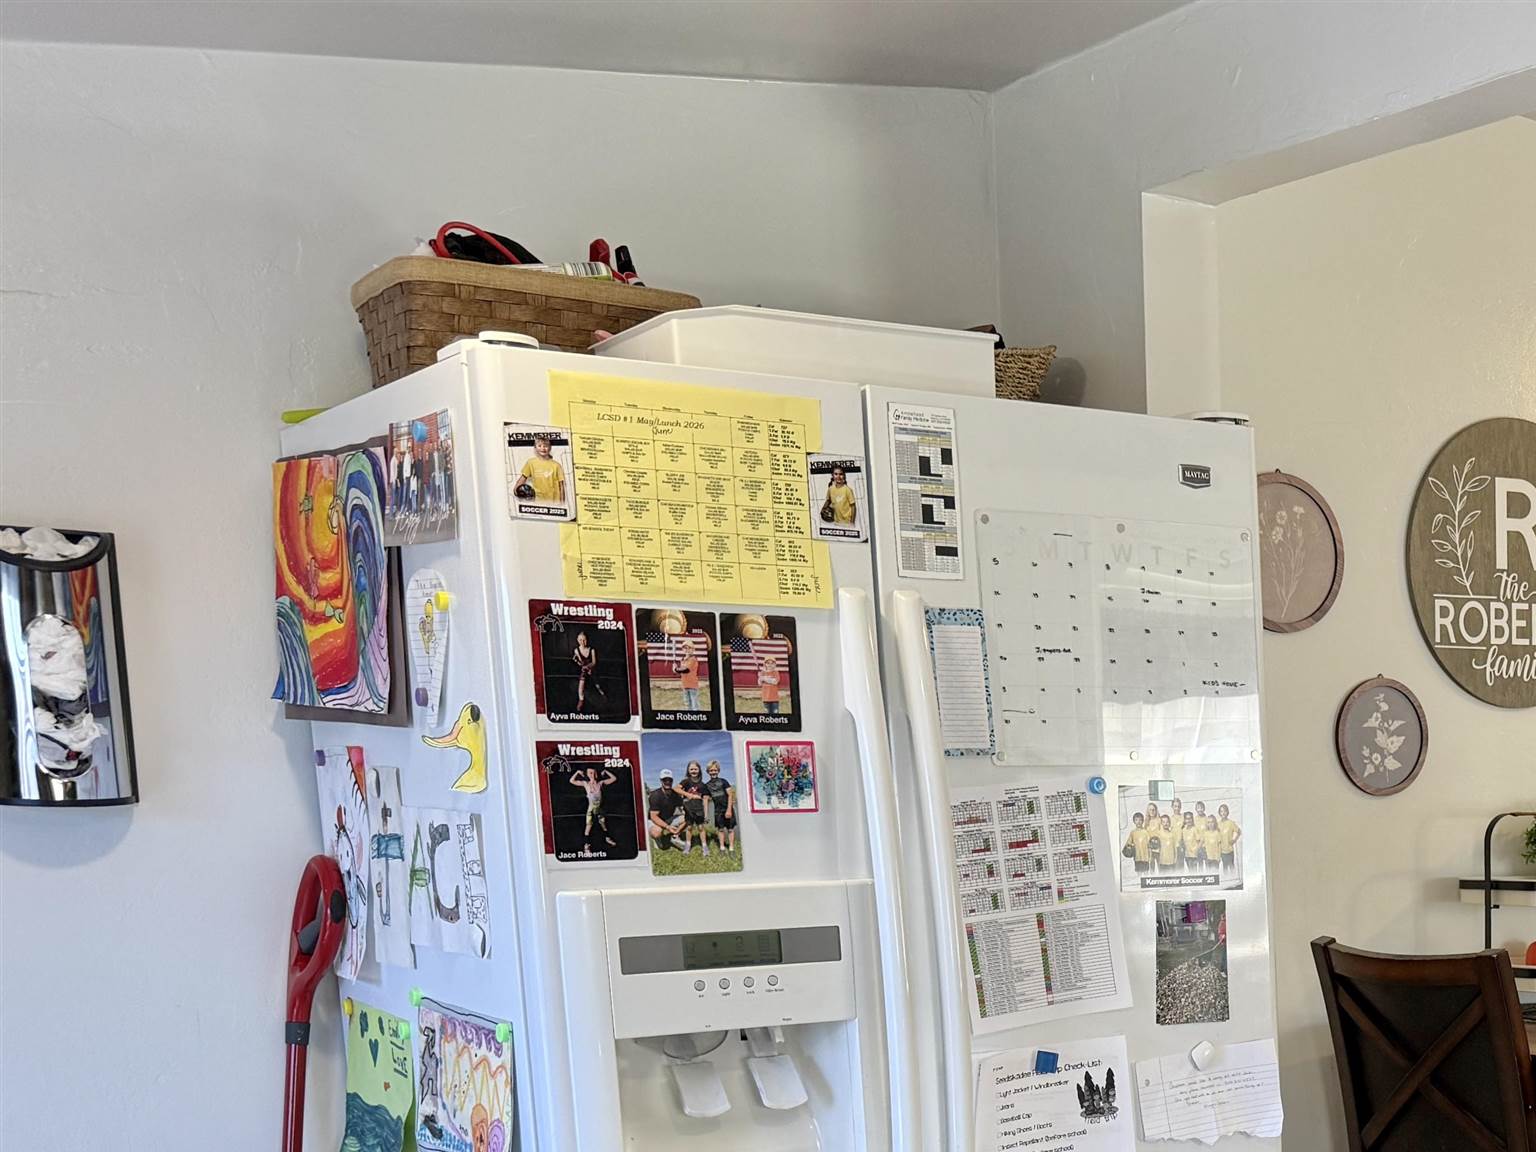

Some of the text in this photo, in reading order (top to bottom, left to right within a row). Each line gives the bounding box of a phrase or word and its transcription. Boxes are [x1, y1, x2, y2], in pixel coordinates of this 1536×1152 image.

[597, 413, 620, 422] LCSD
[1184, 470, 1210, 480] MAYTAG
[521, 506, 549, 514] SOCCER
[550, 603, 614, 620] Wrestling
[598, 619, 624, 631] 2024
[550, 713, 600, 722] Ayva Roberts
[655, 712, 708, 722] Jace Roberts
[738, 715, 789, 725] Ayva Roberts
[558, 744, 621, 758] Wrestling
[604, 758, 630, 768] 2024
[558, 850, 607, 860] Jace Roberts
